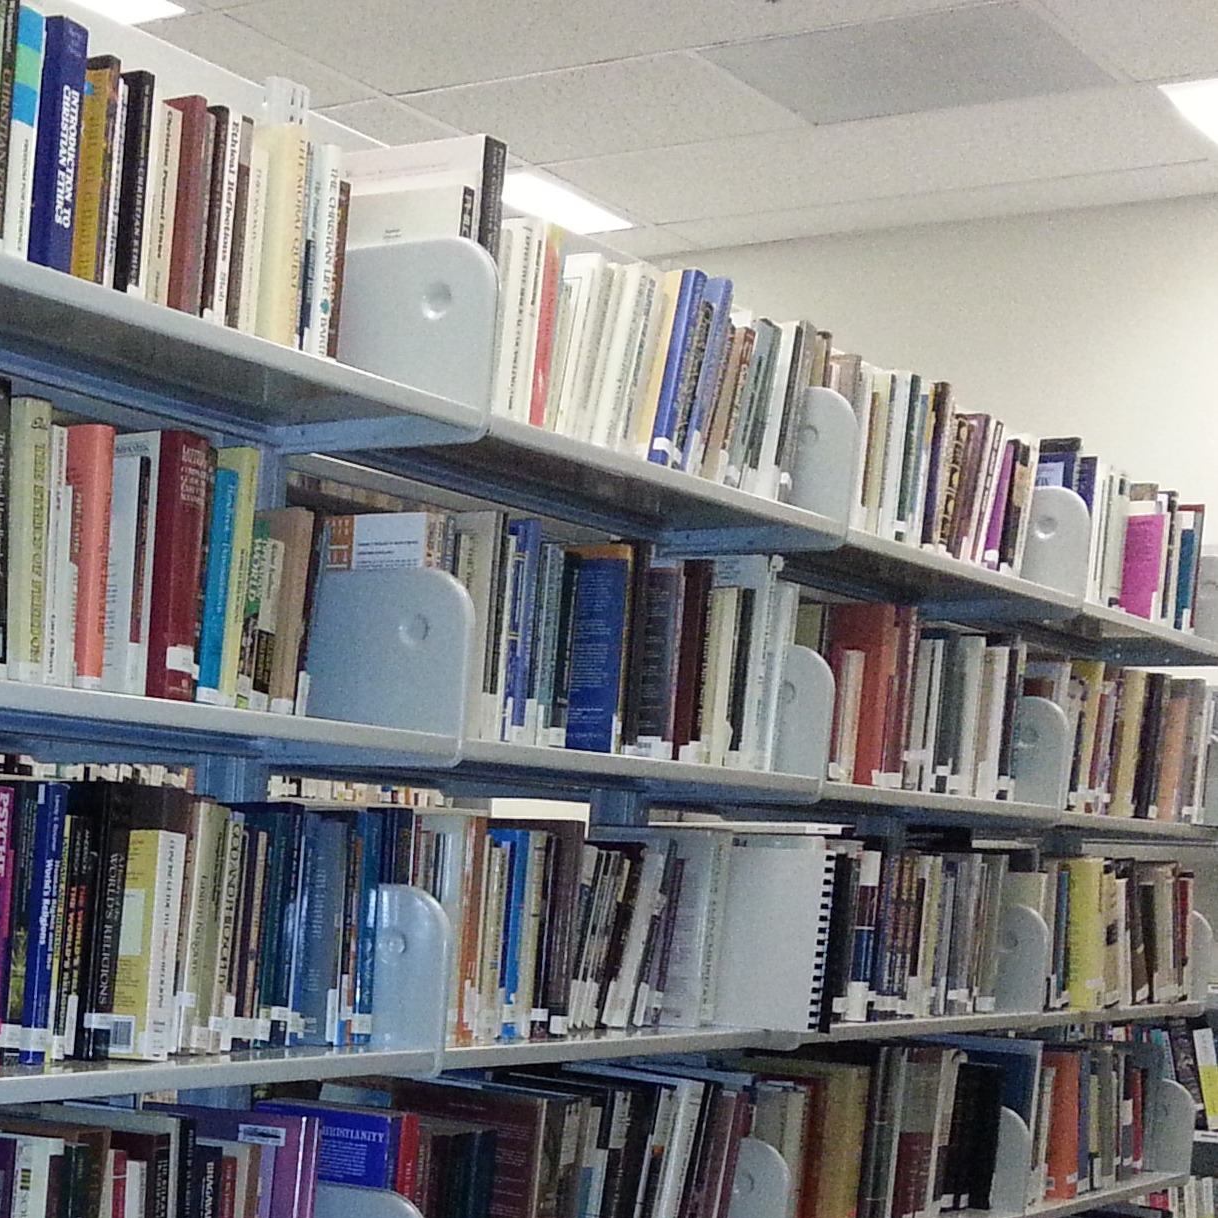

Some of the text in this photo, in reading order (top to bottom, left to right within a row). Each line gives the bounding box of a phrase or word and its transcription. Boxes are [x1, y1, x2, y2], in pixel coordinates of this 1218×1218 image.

[54, 84, 72, 226] CHRISTIAN ETHICS
[62, 89, 80, 229] INTRODUCTION TO
[220, 121, 240, 262] Ethical Reflections
[99, 852, 118, 1006] WORLD'S RELIGIONS
